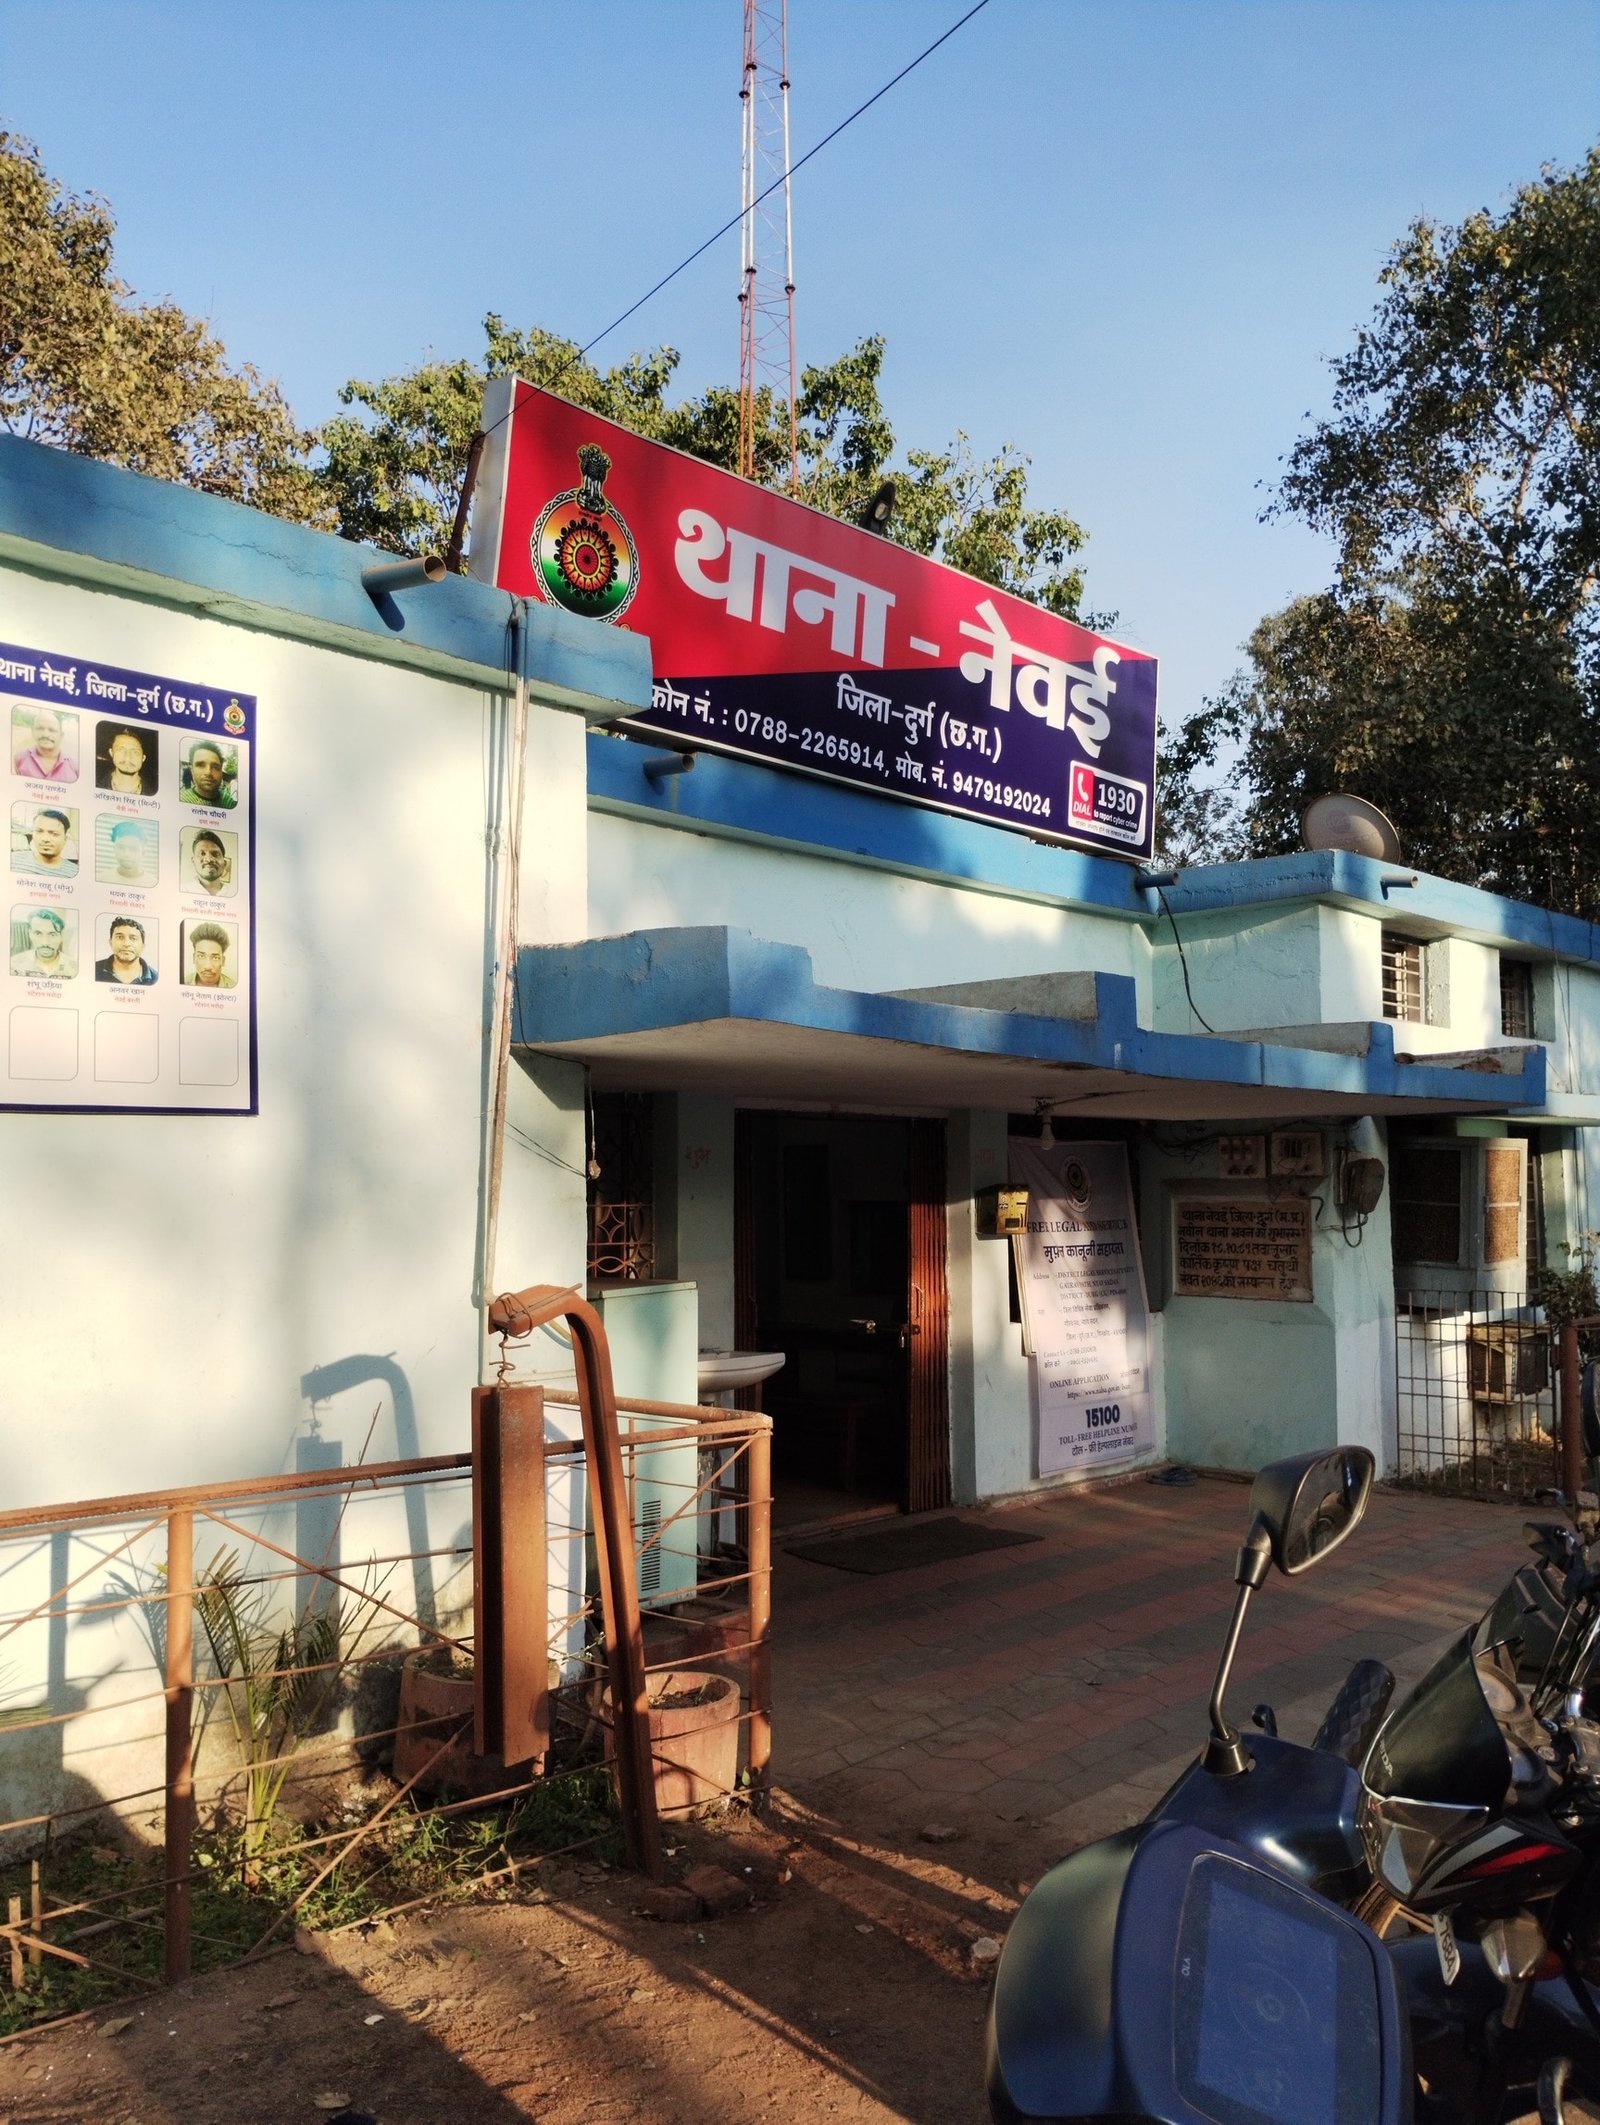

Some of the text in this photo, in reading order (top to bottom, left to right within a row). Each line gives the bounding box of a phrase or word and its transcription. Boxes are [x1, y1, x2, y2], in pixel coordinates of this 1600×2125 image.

[674, 508, 896, 668] थाना
[958, 599, 1121, 758] नेवई
[39, 661, 81, 697] नेवई,
[85, 671, 161, 714] जिला-दुर्ग
[163, 690, 214, 724] (छ.ग.)
[836, 672, 1002, 764] जिला-दुर्ग (छ.ग.)
[694, 689, 715, 724] नं.
[734, 708, 890, 778] 0788-2265914,
[895, 751, 928, 784] मोब.
[931, 760, 949, 790] नं.
[952, 771, 1052, 818] 9479192024
[1073, 801, 1092, 816] DIAL
[1097, 783, 1136, 815] 1930
[1093, 809, 1138, 830] to report cyber crime
[1049, 1220, 1082, 1233] LEGAL
[1206, 1226, 1230, 1238] थाना
[1065, 1239, 1096, 1262] कानूनी
[1049, 1374, 1110, 1389] ONLINE APPLICATION
[1085, 1404, 1120, 1428] 15100
[1077, 1431, 1092, 1442] FREE
[1092, 1427, 1121, 1439] HELPLINE
[1181, 1957, 1192, 1977] OLA
